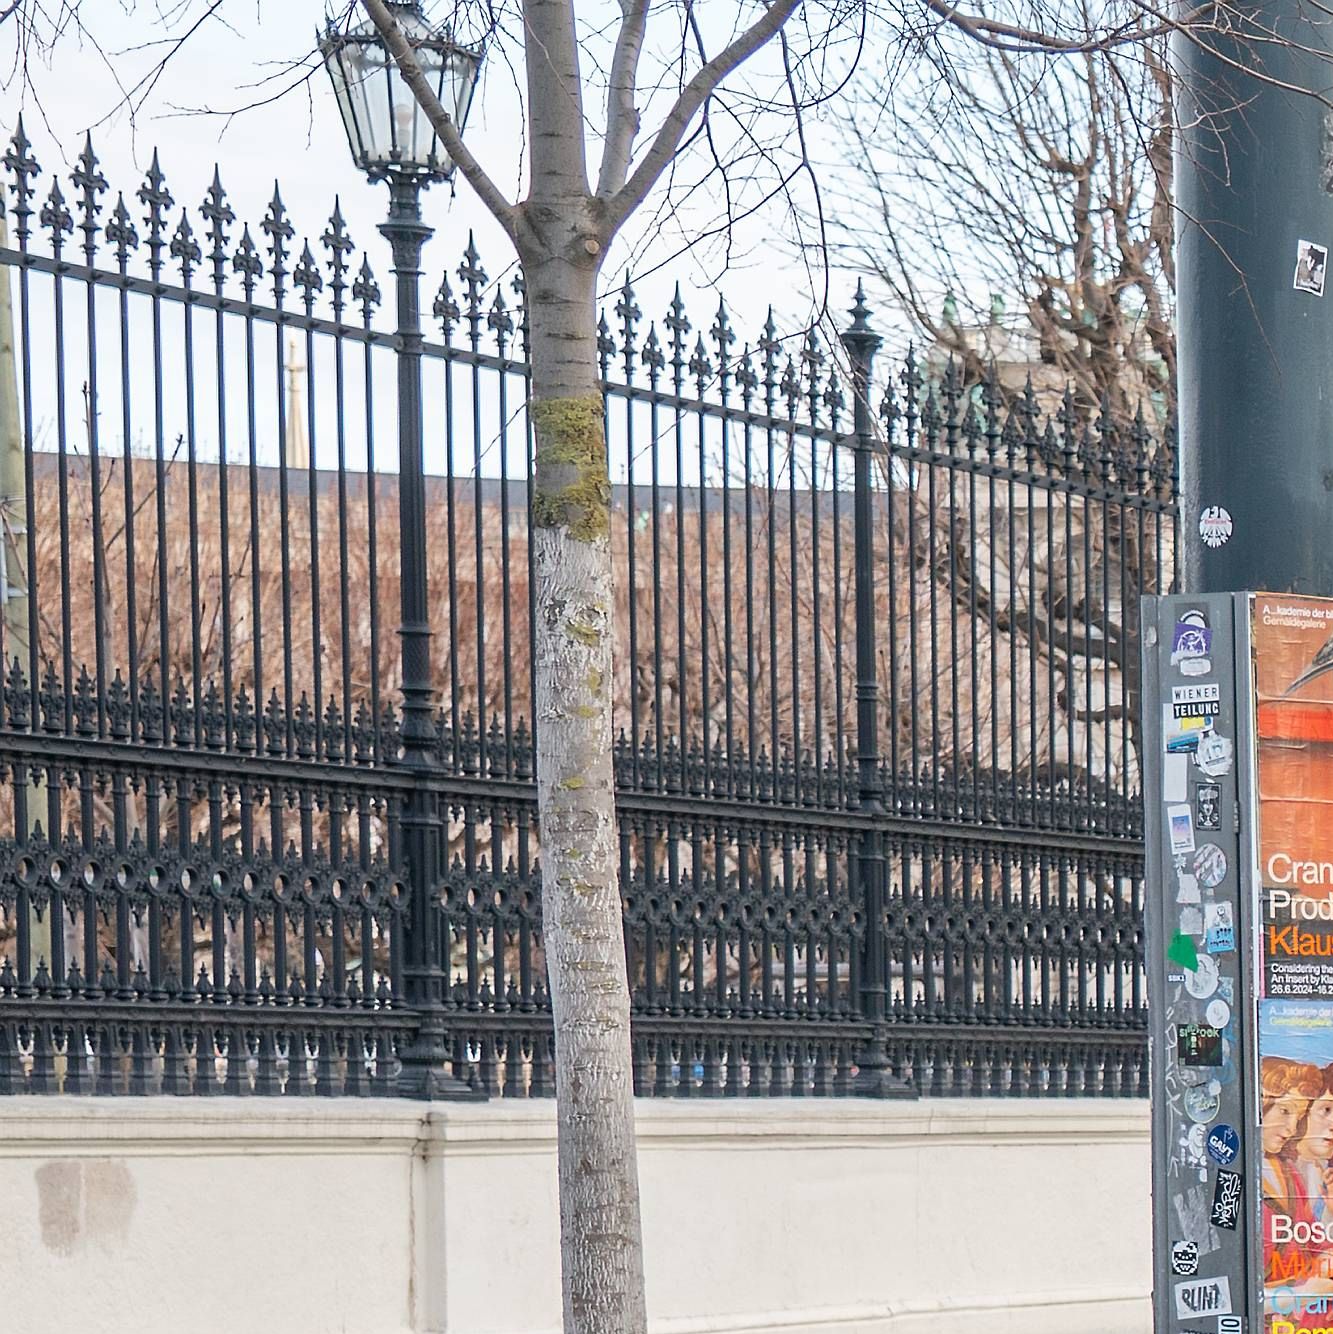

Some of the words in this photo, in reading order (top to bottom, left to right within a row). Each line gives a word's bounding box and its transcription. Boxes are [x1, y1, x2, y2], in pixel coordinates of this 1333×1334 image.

[1312, 608, 1326, 618] der
[1174, 687, 1218, 700] WIENER
[1271, 963, 1320, 975] Considering
[1321, 965, 1333, 973] the
[1271, 974, 1284, 983] An
[1285, 975, 1309, 984] Insert
[1310, 975, 1320, 986] by
[1209, 1135, 1234, 1157] GAYT
